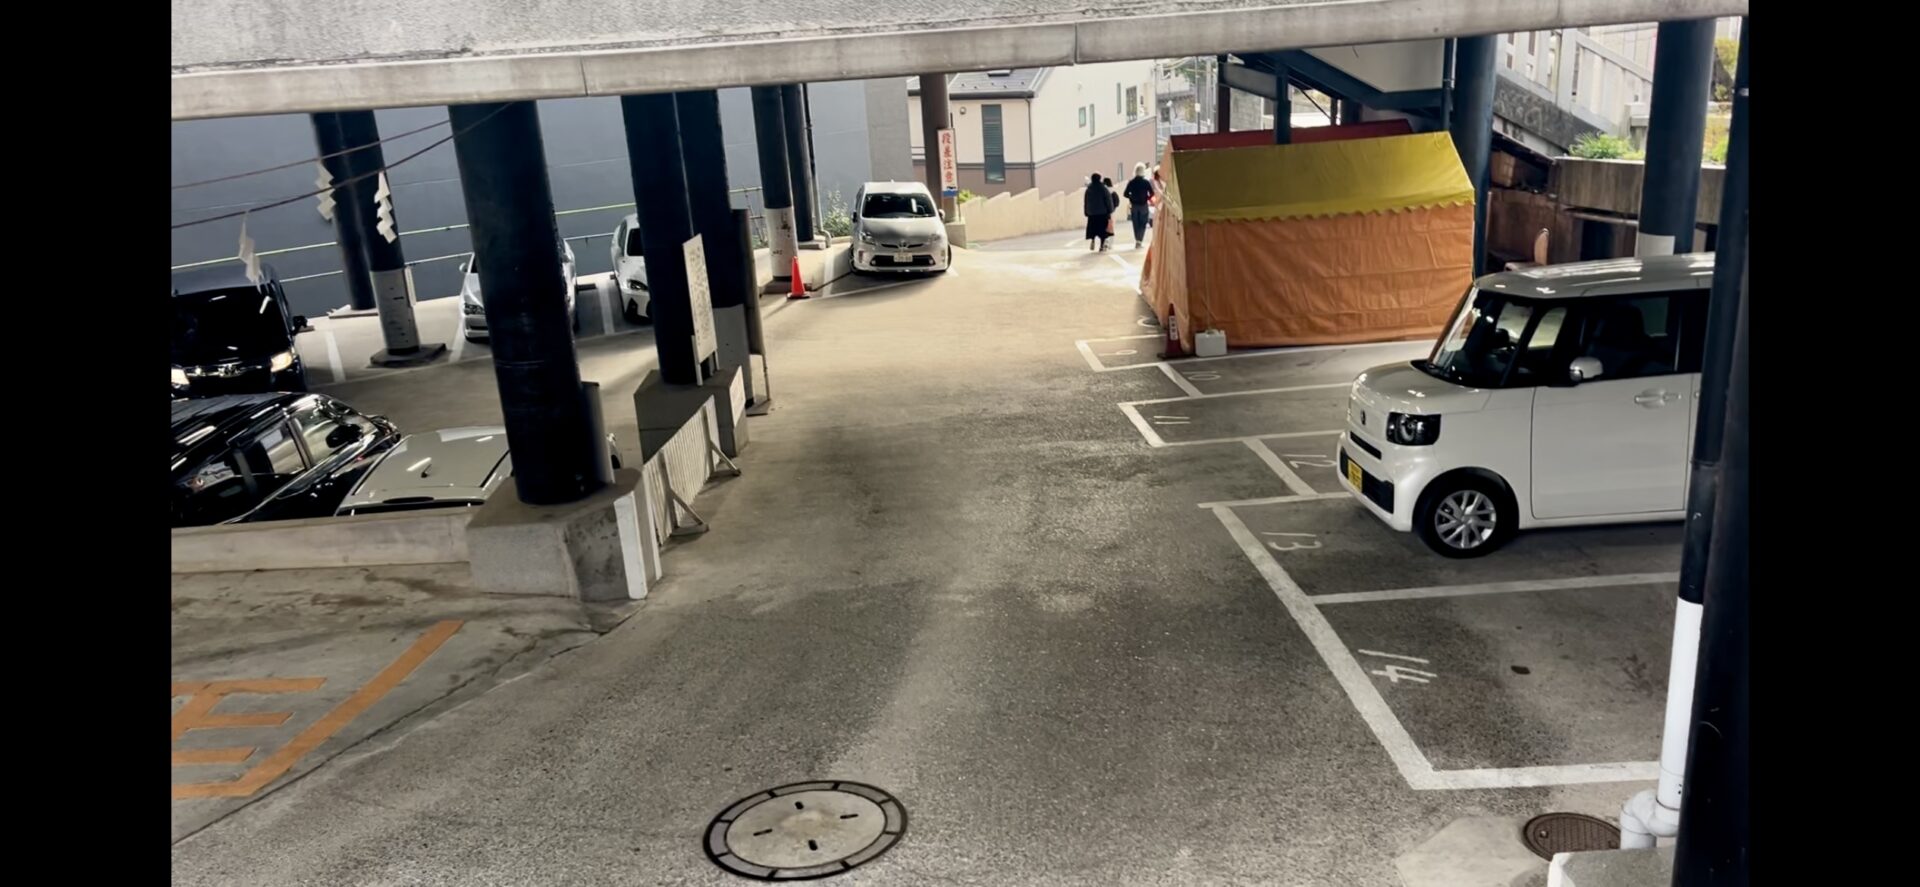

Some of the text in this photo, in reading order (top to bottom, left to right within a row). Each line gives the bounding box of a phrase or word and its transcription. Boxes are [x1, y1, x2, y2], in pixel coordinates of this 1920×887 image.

[1182, 370, 1222, 381] 10
[1153, 415, 1191, 425] 11
[1281, 453, 1338, 469] 12
[1261, 531, 1322, 551] 13
[1358, 648, 1438, 683] 14
